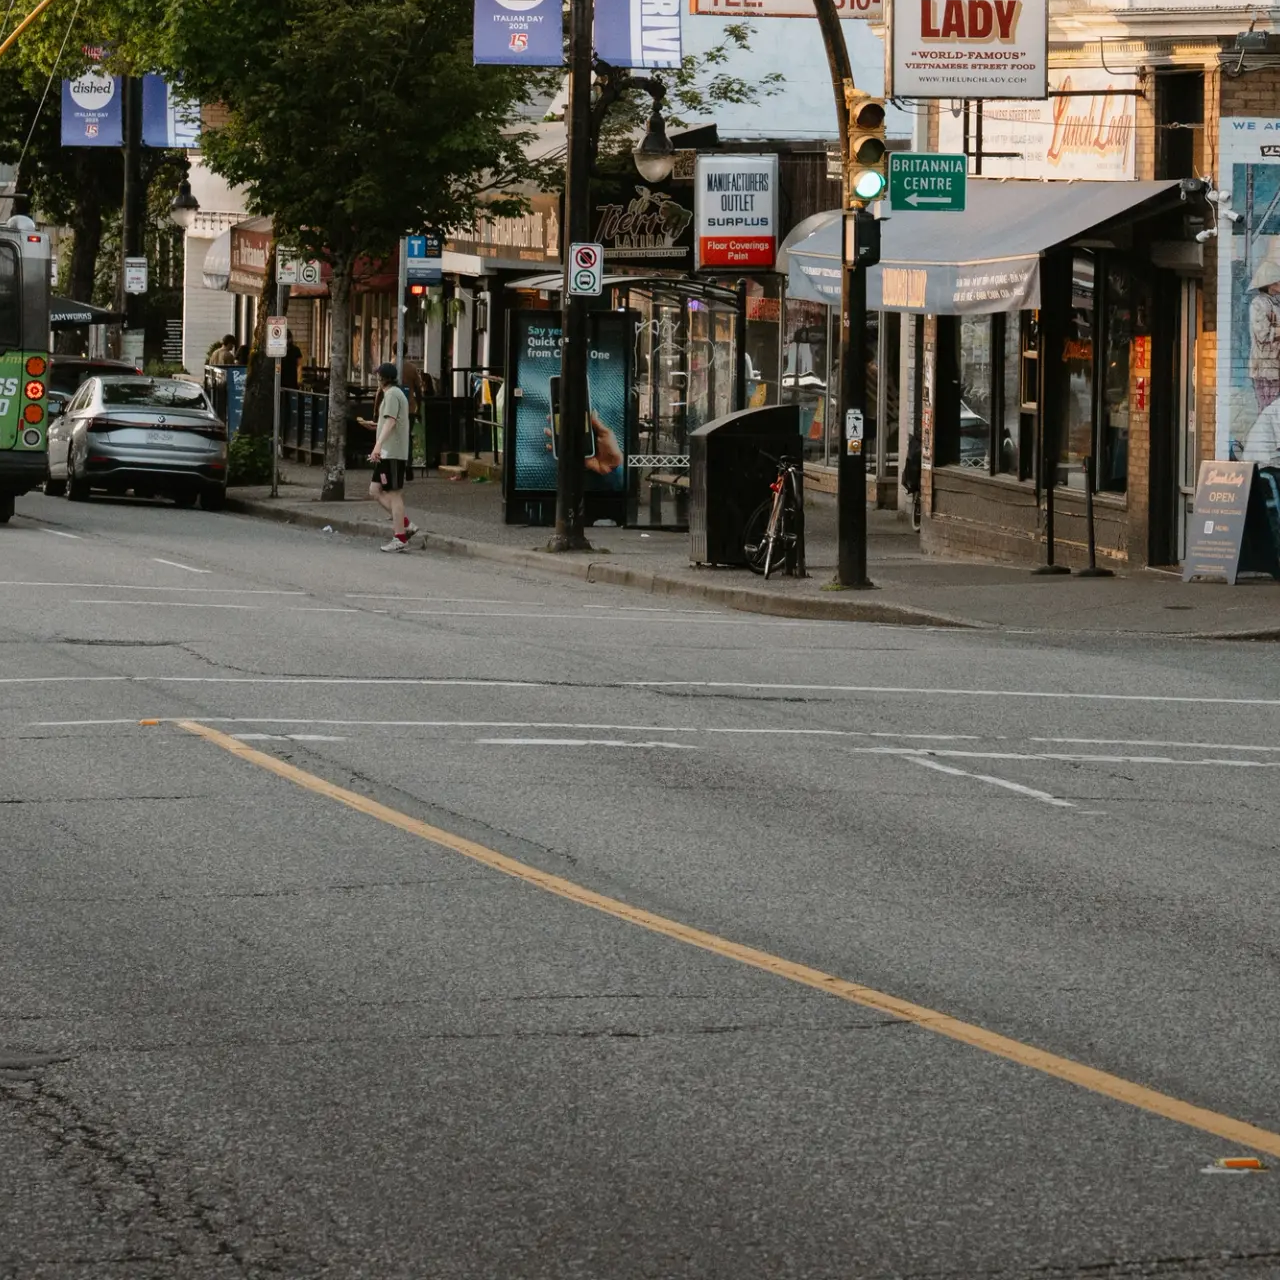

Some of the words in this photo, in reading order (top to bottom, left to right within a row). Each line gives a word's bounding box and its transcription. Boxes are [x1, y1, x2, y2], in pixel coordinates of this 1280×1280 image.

[526, 15, 544, 23] DAY
[921, 0, 1020, 42] LADY
[73, 81, 111, 94] dished
[1047, 75, 1096, 160] Lunch
[1093, 84, 1133, 173] Lady
[1233, 122, 1256, 130] WE
[892, 159, 963, 173] BRITANNIA
[707, 173, 769, 192] MANUFACTURERS
[904, 177, 952, 190] CENTRE
[721, 194, 755, 212] OUTLET
[707, 217, 769, 227] SURPLUS
[707, 241, 728, 250] Floor
[729, 241, 769, 251] Coverings
[728, 252, 748, 260] Paint
[528, 326, 546, 336] Say
[528, 337, 556, 347] Quick
[527, 348, 551, 358] from
[590, 350, 610, 360] One
[1209, 492, 1236, 502] OPEN
